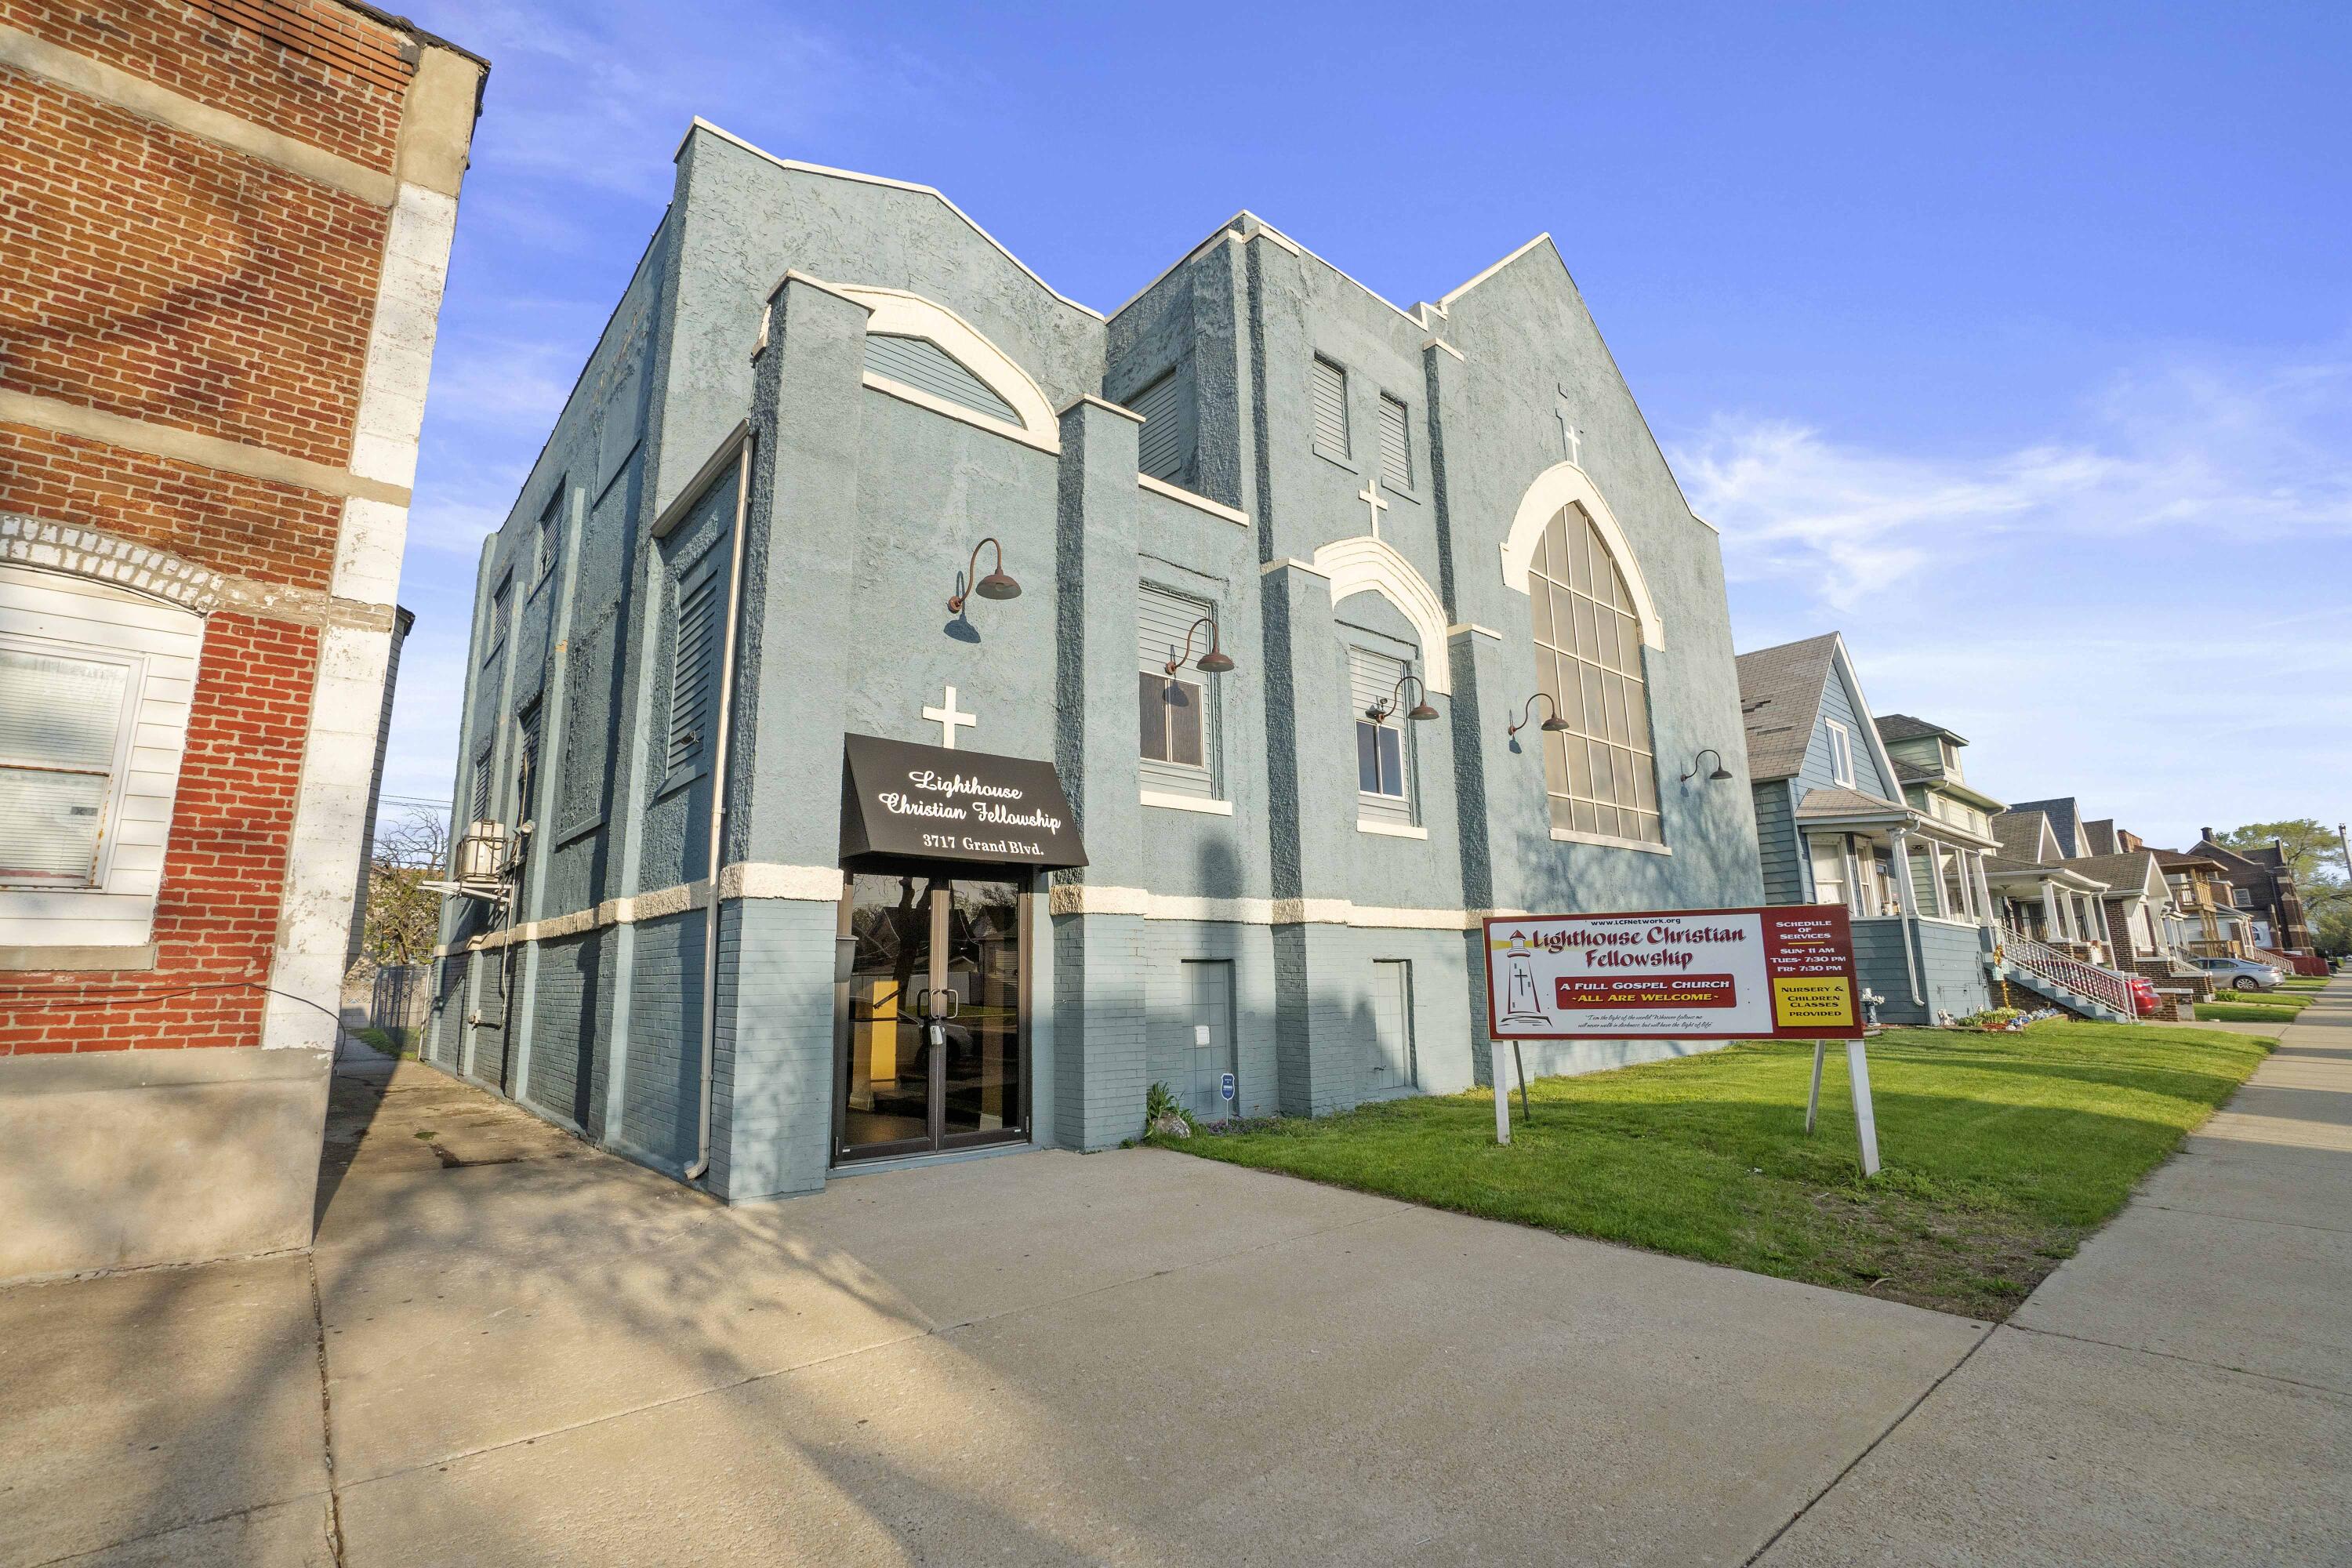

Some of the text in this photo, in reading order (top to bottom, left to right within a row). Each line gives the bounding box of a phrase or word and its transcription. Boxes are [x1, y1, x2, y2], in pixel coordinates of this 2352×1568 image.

[909, 771, 1022, 799] Lighthouse
[878, 793, 1062, 835] Christian Fellowship
[923, 834, 1044, 855] 3717 Grand Blvd.
[1532, 926, 1746, 953] Lighthouse Christian
[1585, 949, 1693, 971] Fellowship
